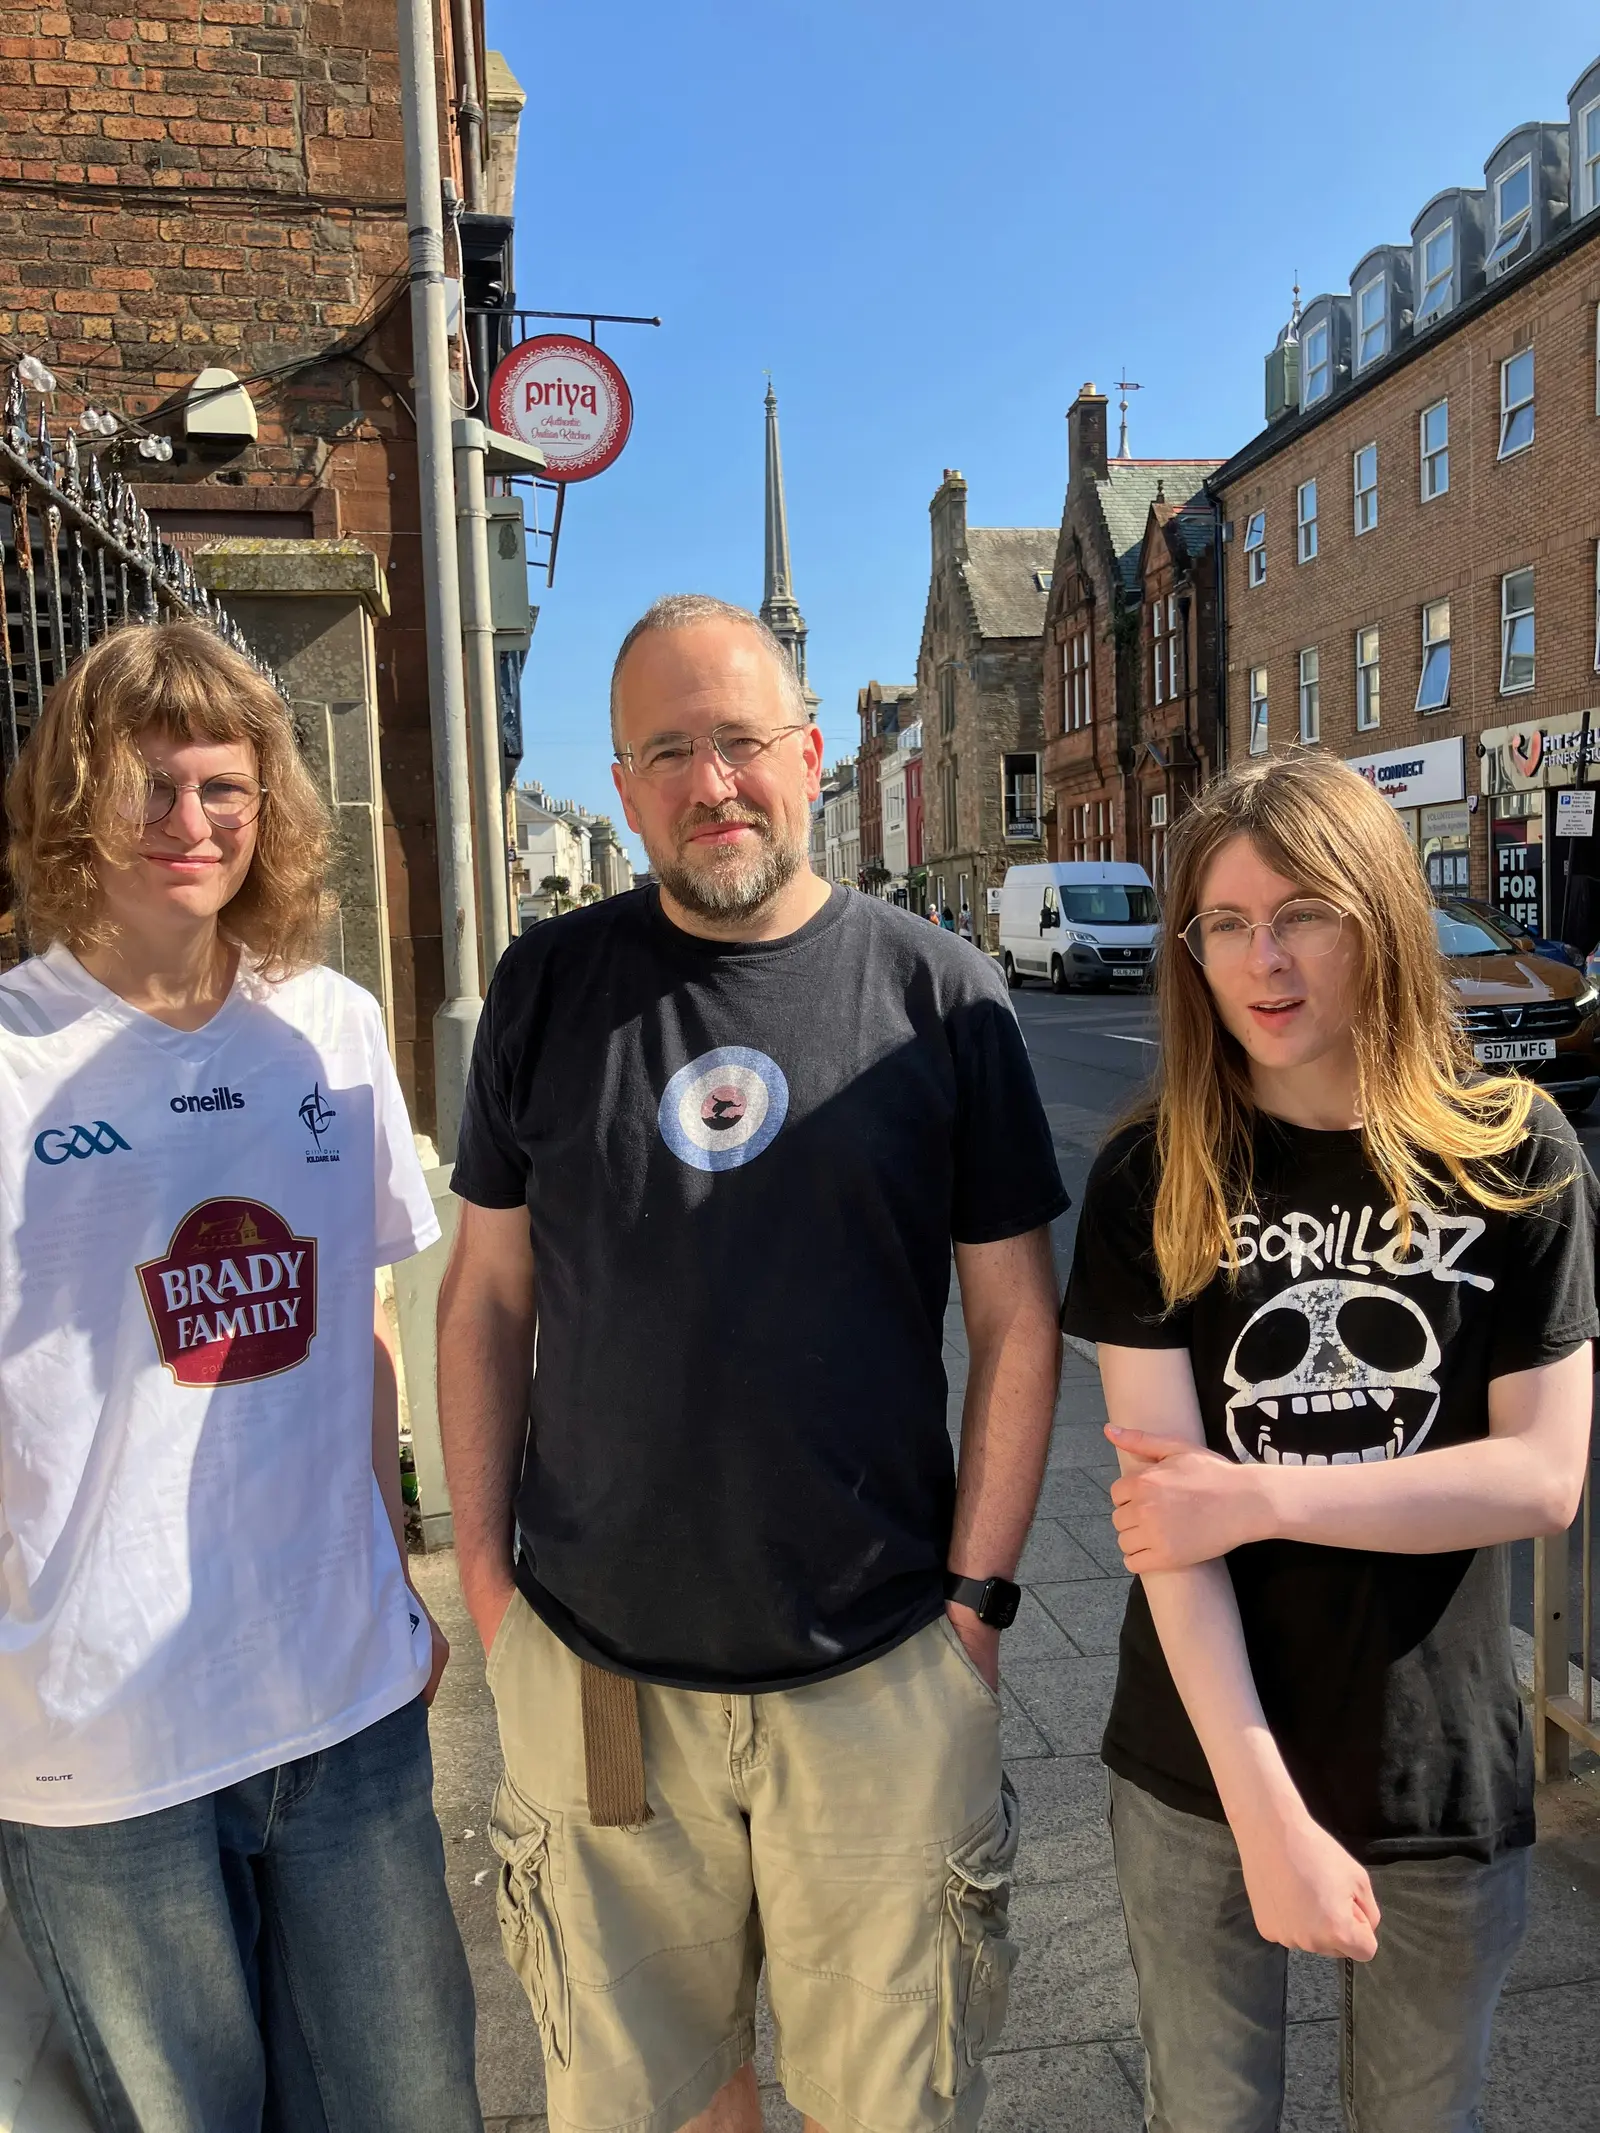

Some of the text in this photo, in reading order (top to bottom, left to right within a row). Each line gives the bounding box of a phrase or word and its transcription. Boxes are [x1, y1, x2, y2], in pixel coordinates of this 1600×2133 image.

[526, 377, 597, 416] priya
[1543, 734, 1562, 752] FIT
[1378, 760, 1424, 781] CONNECT
[1499, 848, 1527, 872] FIT
[1499, 875, 1537, 899] FOR
[1484, 1042, 1547, 1060] SD71 WFG
[158, 1250, 306, 1313] BRADY
[177, 1297, 302, 1350] FAMILY
